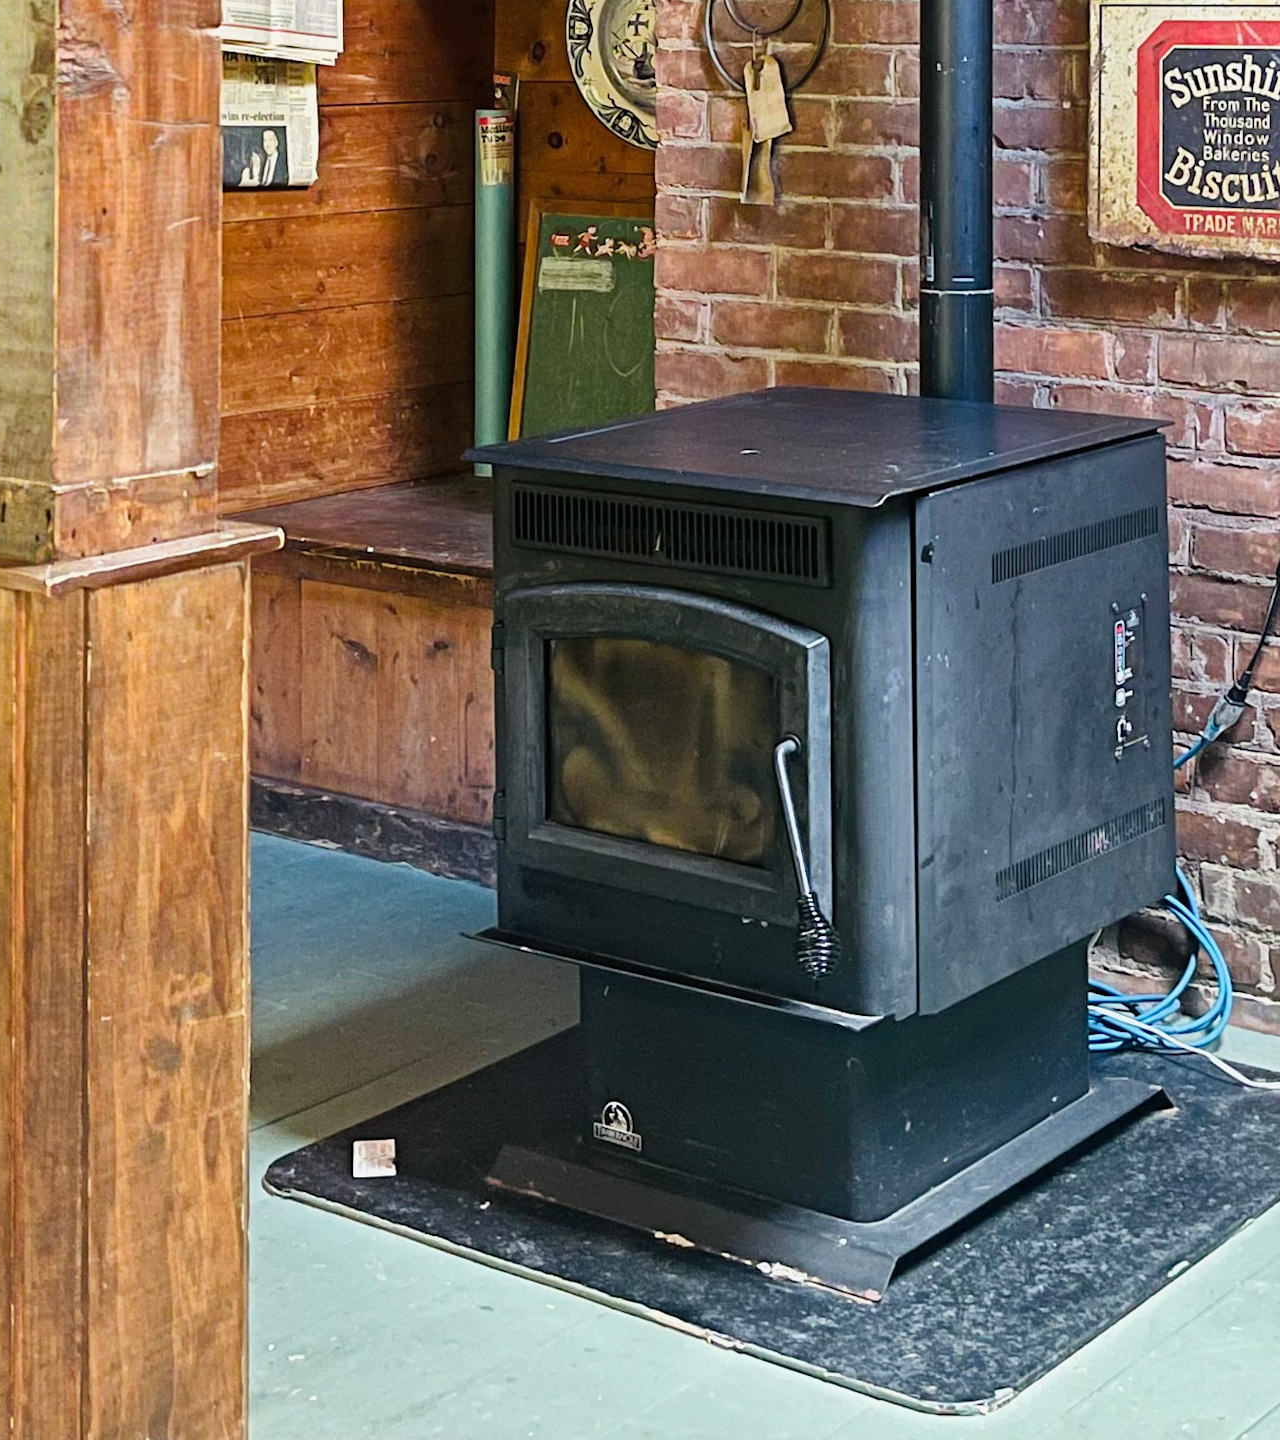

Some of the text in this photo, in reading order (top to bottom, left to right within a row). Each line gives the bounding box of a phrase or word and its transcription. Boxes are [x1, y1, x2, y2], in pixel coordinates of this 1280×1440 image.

[1203, 96, 1270, 112] From The
[241, 111, 285, 122] re-election
[1203, 113, 1271, 130] Thousand
[1203, 129, 1270, 146] Window
[1203, 146, 1270, 162] Bakeries
[1183, 214, 1236, 234] TRADE
